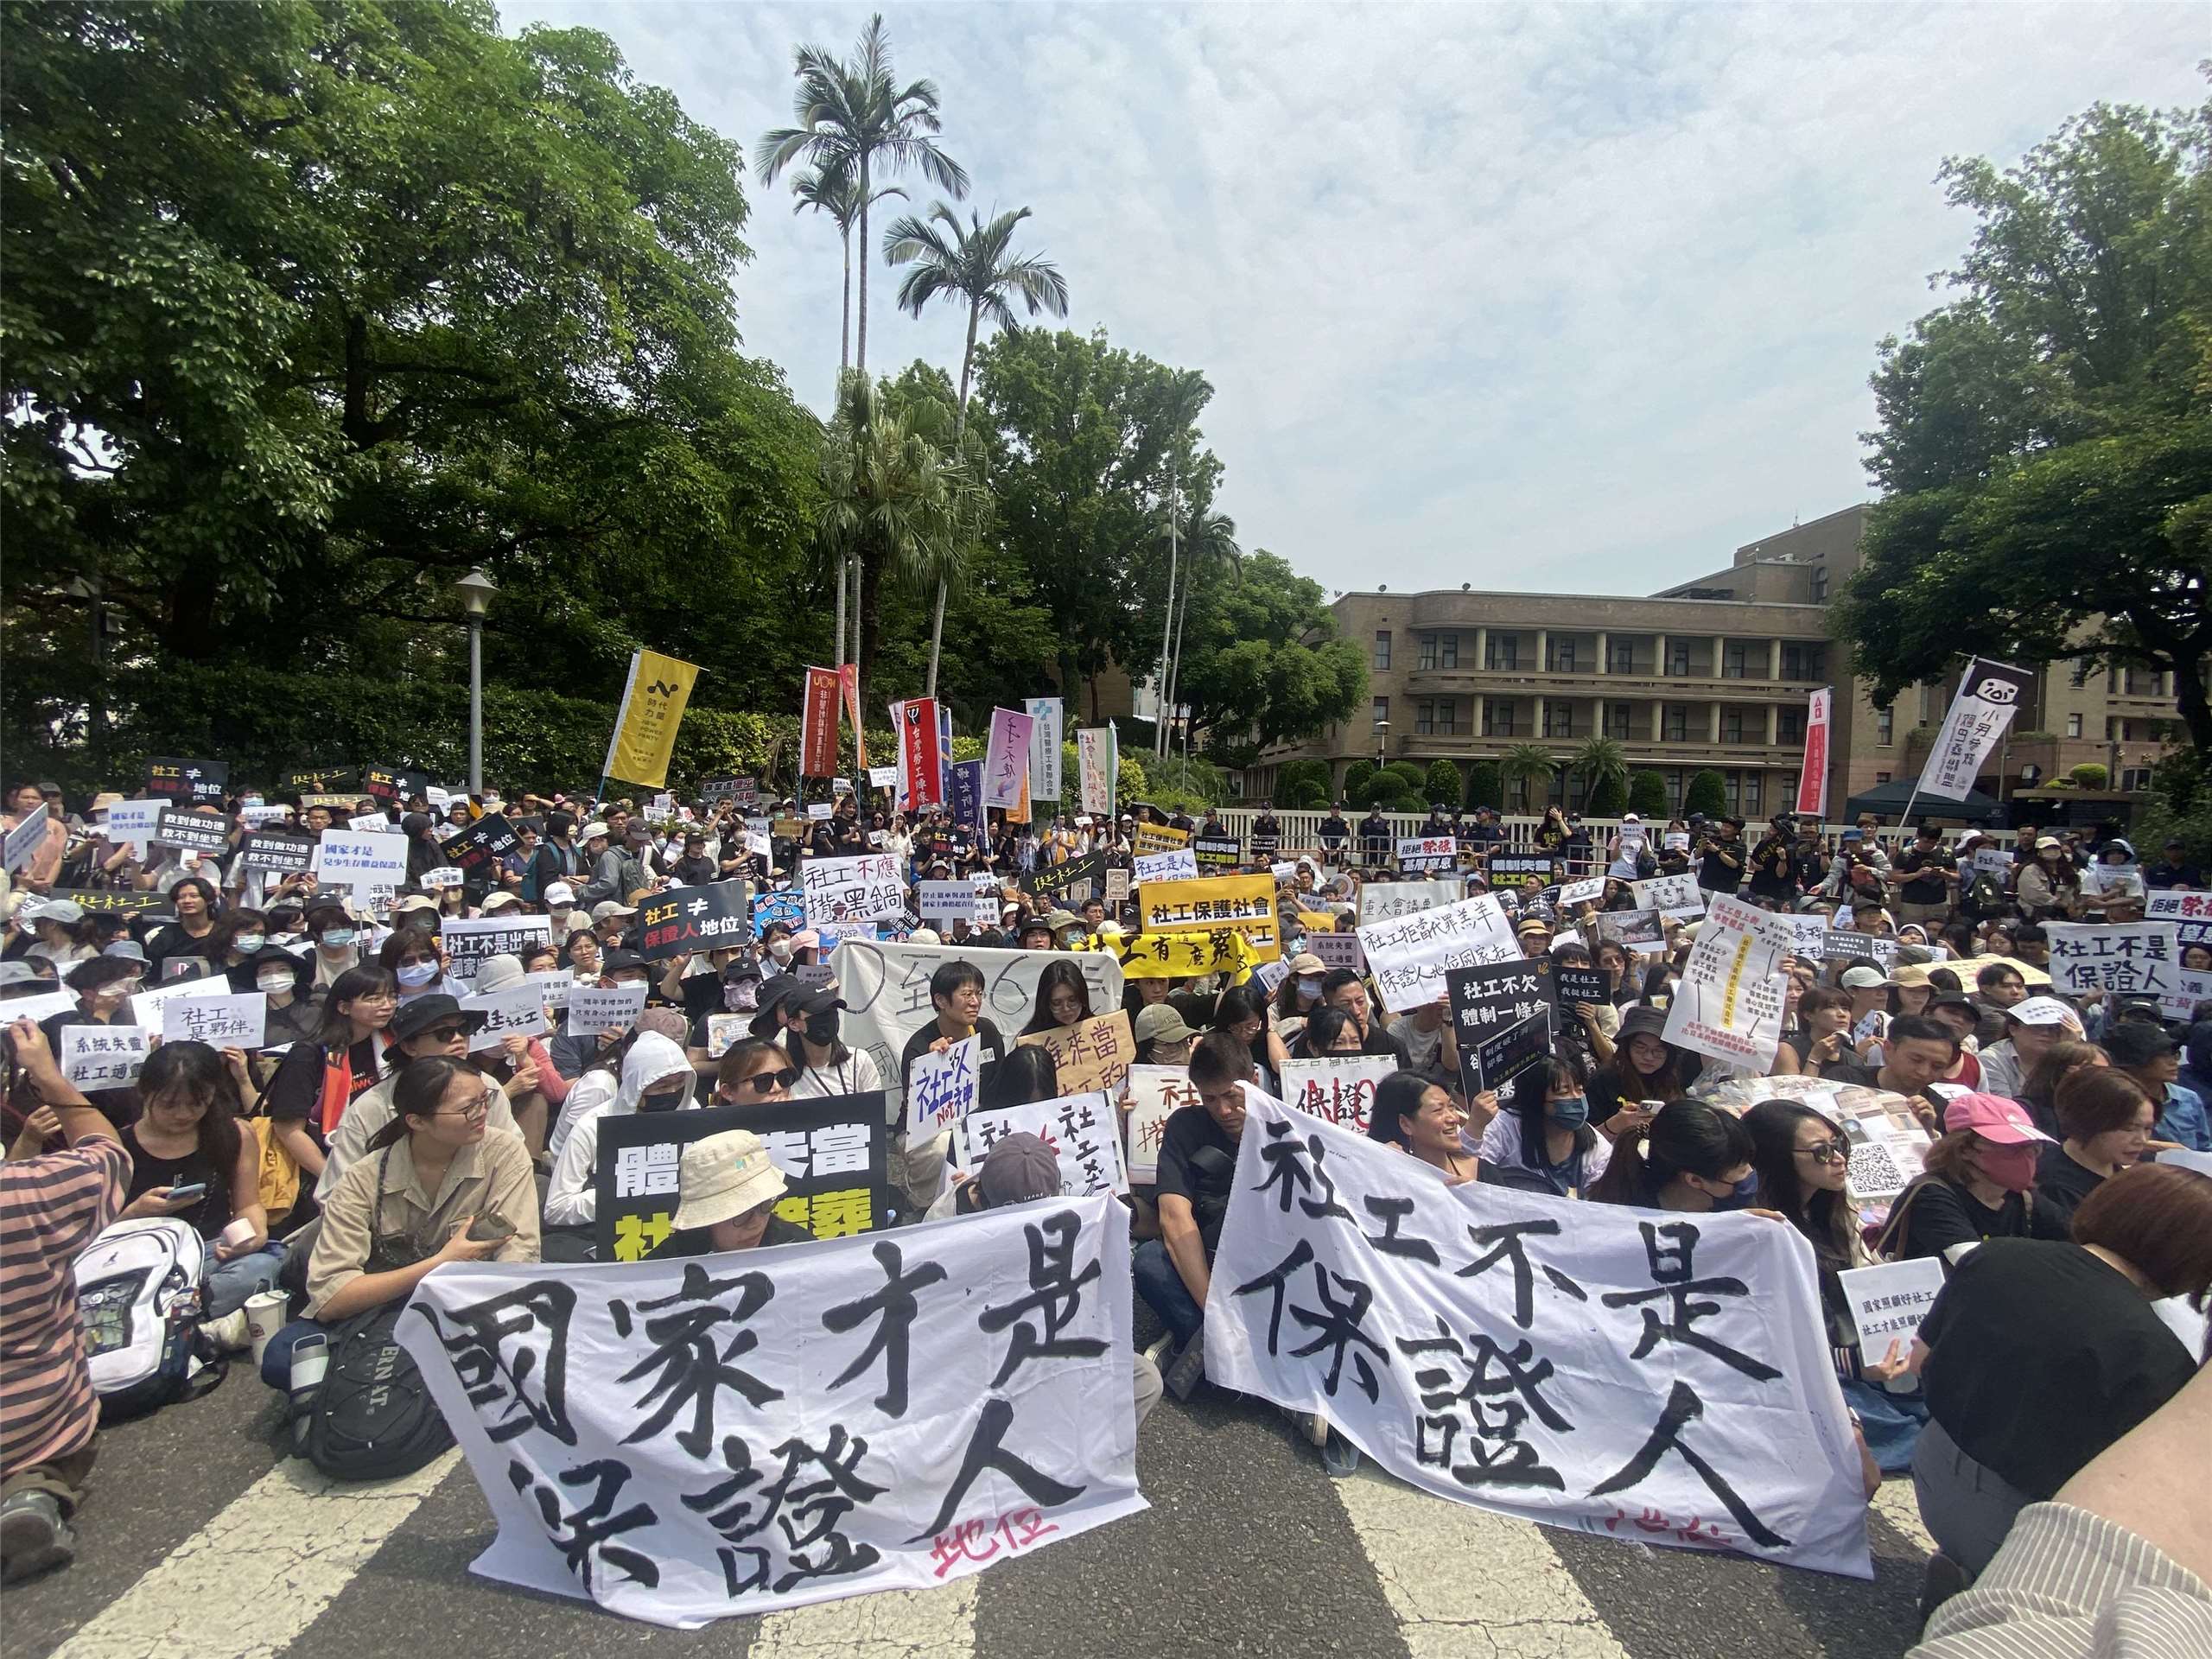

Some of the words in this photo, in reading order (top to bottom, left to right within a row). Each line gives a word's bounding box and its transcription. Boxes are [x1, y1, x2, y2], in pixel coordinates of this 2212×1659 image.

[325, 843, 373, 856] 國家才是
[804, 855, 900, 890] 社工不應
[1137, 855, 1193, 877] 社工是人
[645, 901, 678, 926] 社工
[1152, 896, 1269, 925] 社工保護社會
[644, 916, 740, 948] 保證人地位
[2052, 935, 2170, 962] 社工不是
[1464, 973, 1541, 1001] 社工不欠
[2064, 960, 2169, 993] 保證人
[181, 1007, 229, 1026] 社工
[76, 1037, 144, 1052] 系統失靈
[1252, 1119, 1783, 1382] 社工不是
[410, 1210, 1110, 1461] 國家才是
[1230, 1238, 1793, 1548] 保證人
